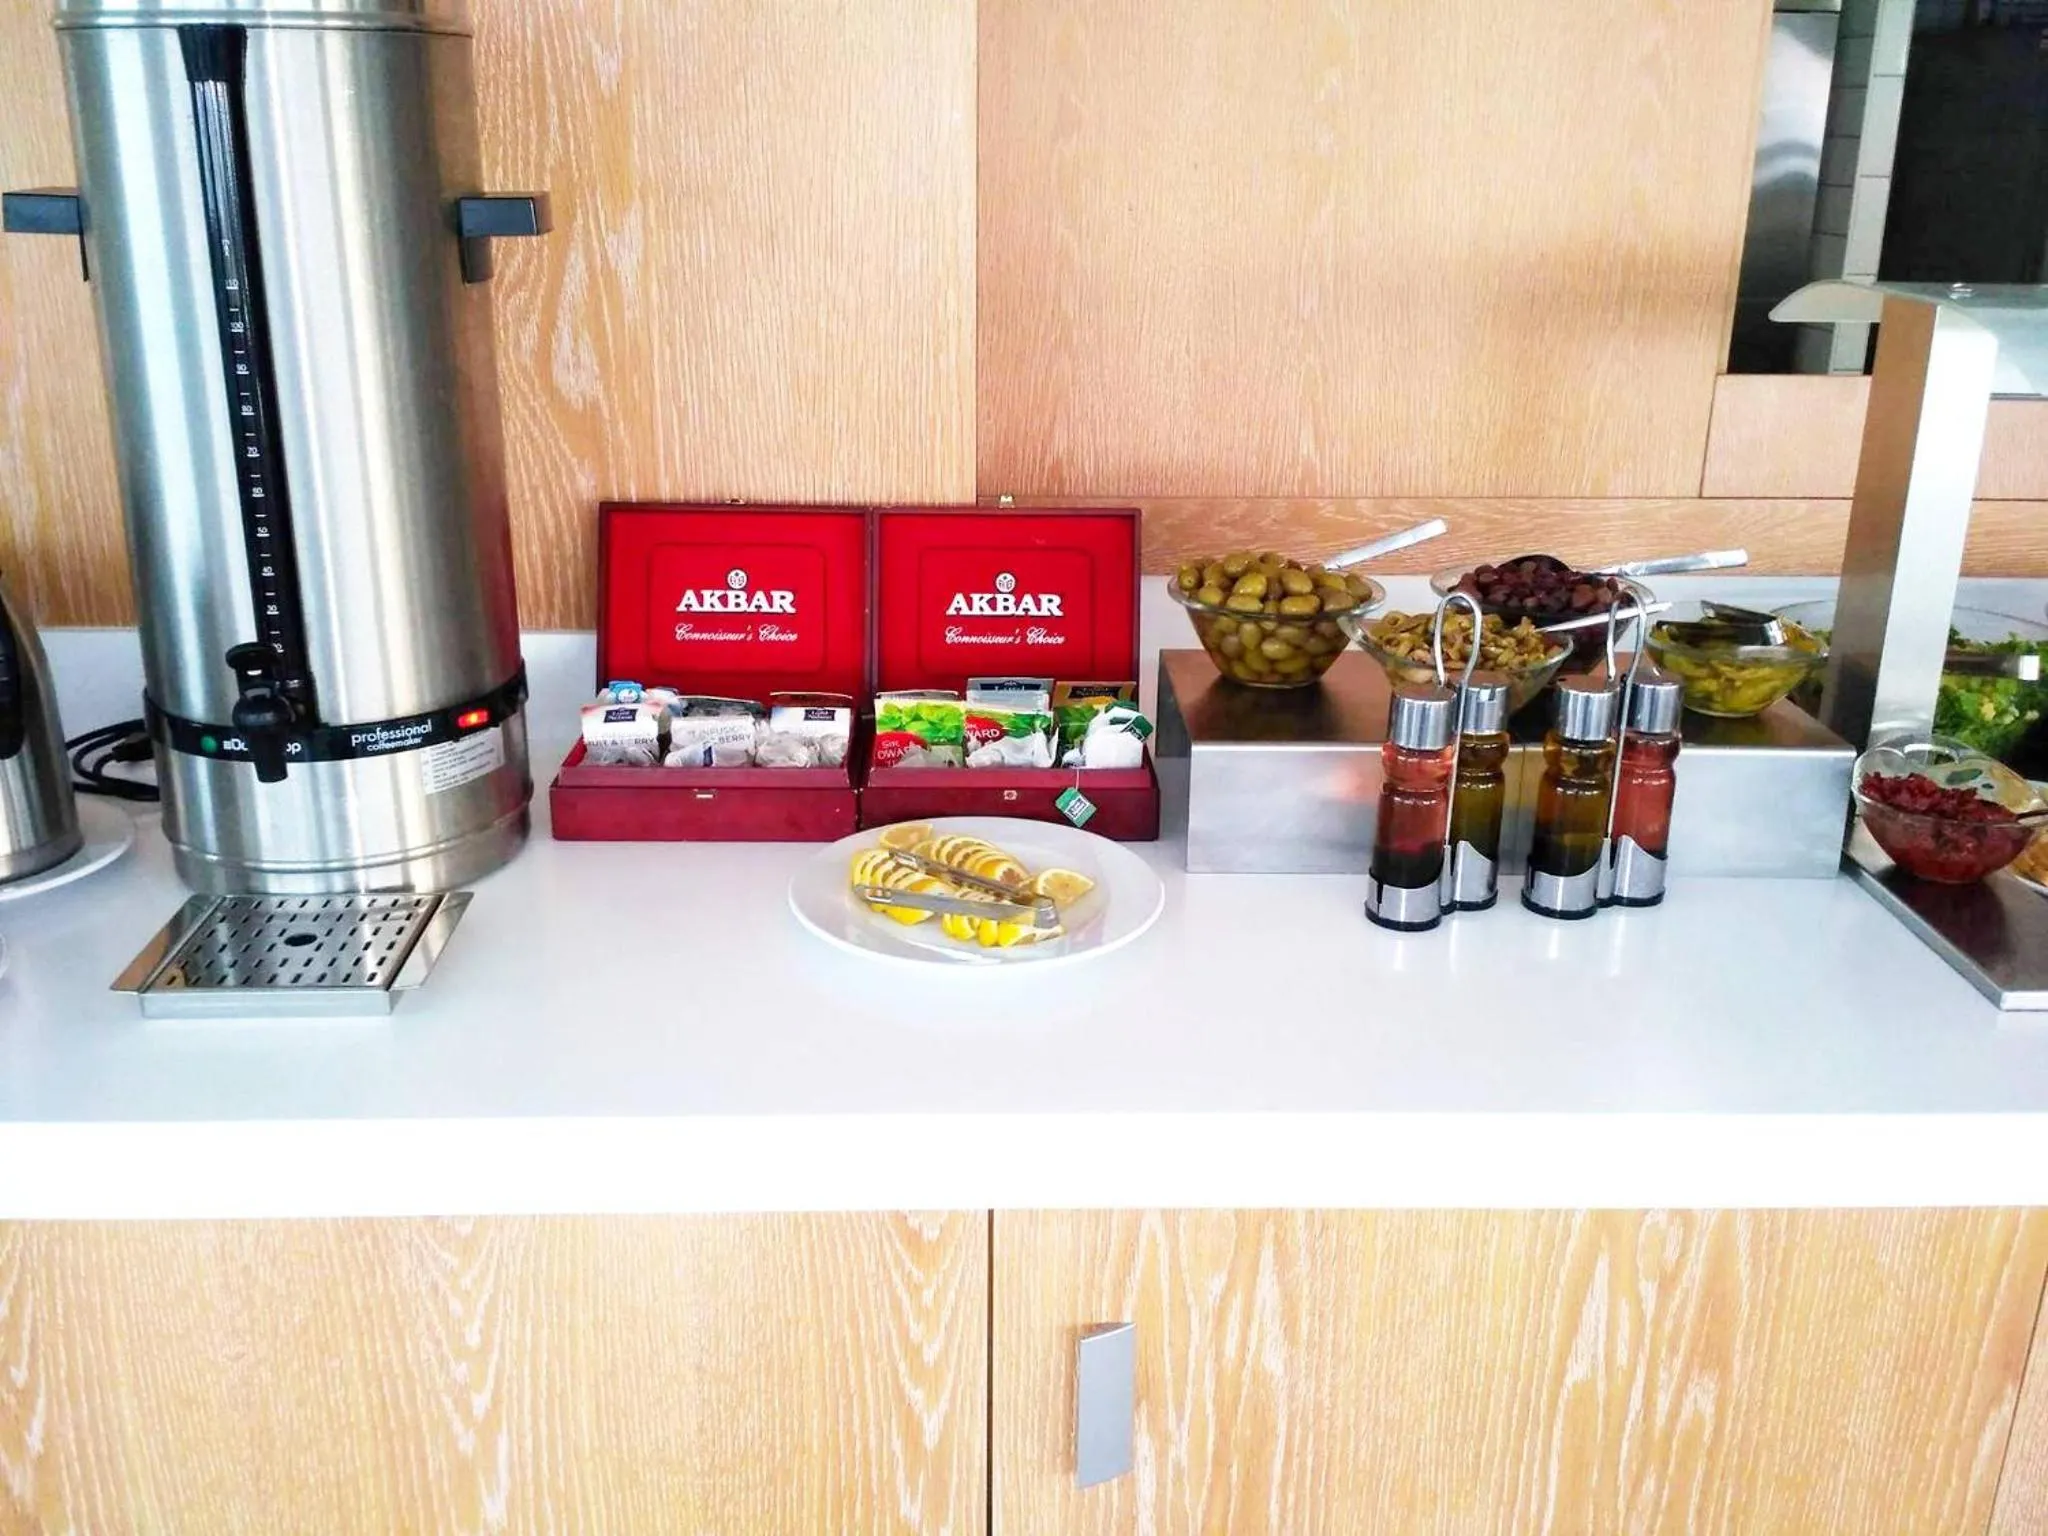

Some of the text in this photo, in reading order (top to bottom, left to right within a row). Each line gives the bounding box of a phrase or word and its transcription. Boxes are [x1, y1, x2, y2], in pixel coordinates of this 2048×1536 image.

[676, 589, 796, 614] AKBAR
[946, 592, 1064, 617] AKBAR
[675, 622, 798, 641] Connoisseur's Choice
[945, 626, 1066, 645] Connoisseur's Choice
[351, 719, 433, 747] professional
[366, 736, 423, 752] coffeemaker
